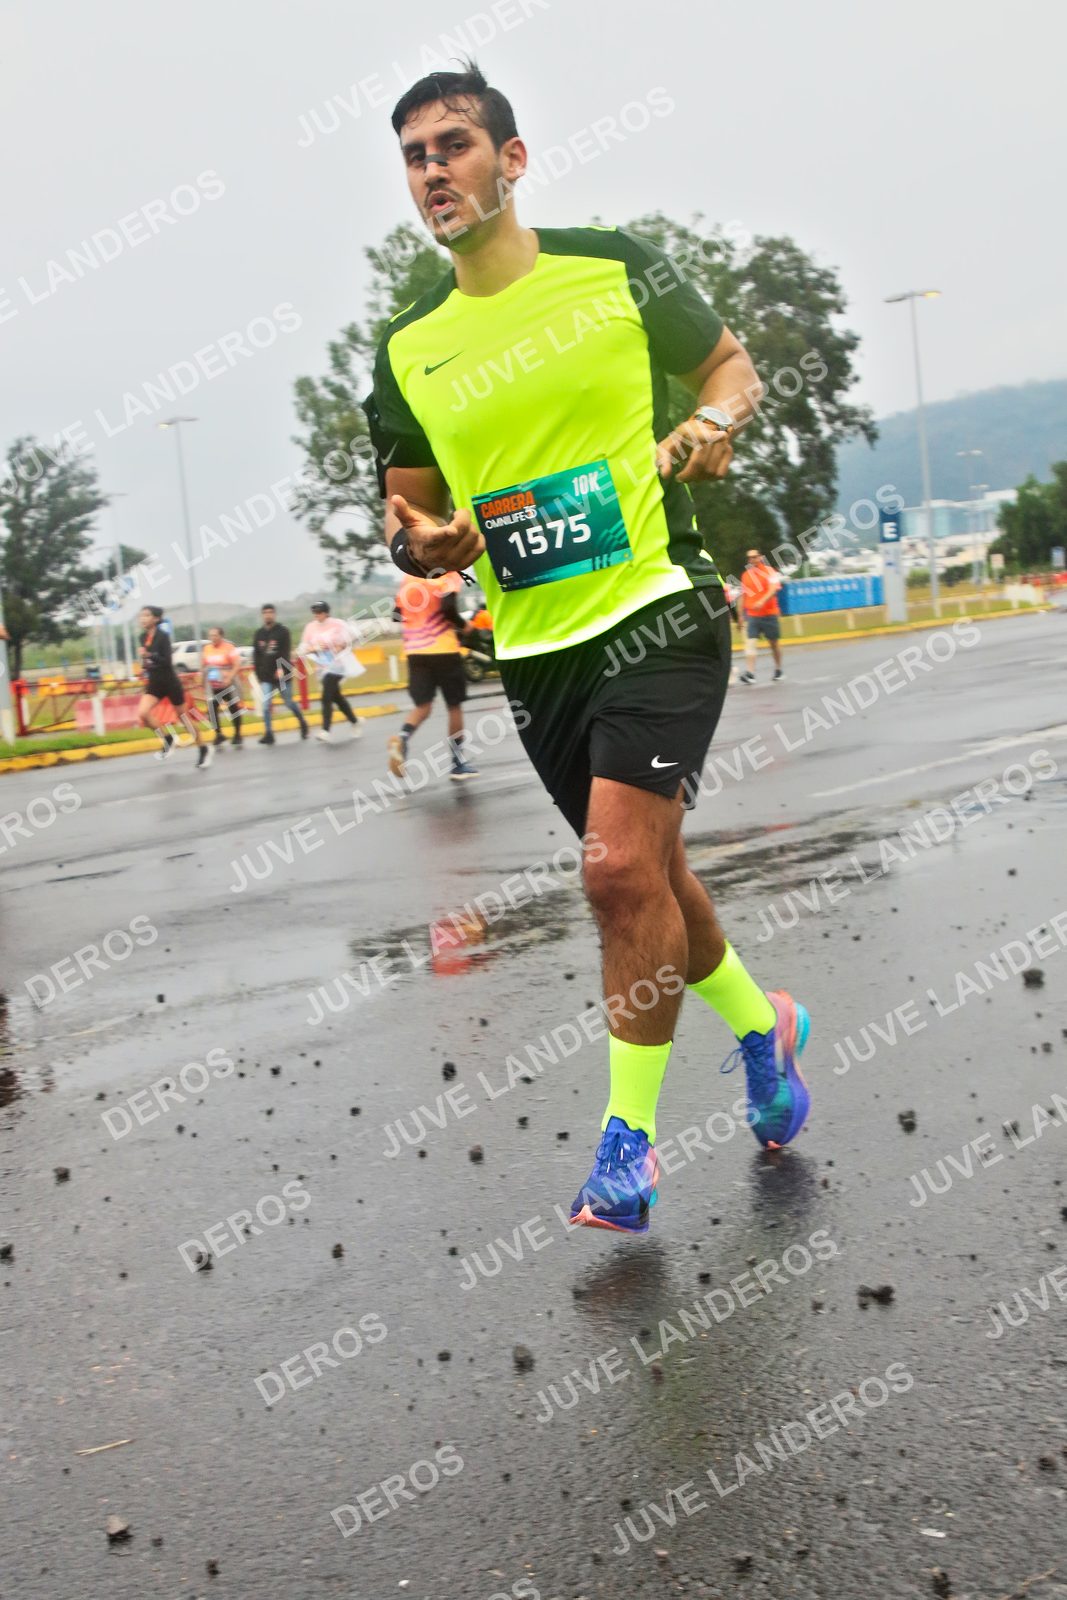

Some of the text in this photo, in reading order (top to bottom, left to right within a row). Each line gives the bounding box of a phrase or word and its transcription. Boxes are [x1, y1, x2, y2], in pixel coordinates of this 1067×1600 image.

[571, 471, 601, 497] 10K
[480, 491, 535, 519] CARRERA
[508, 513, 591, 558] 1575
[882, 521, 898, 538] E
